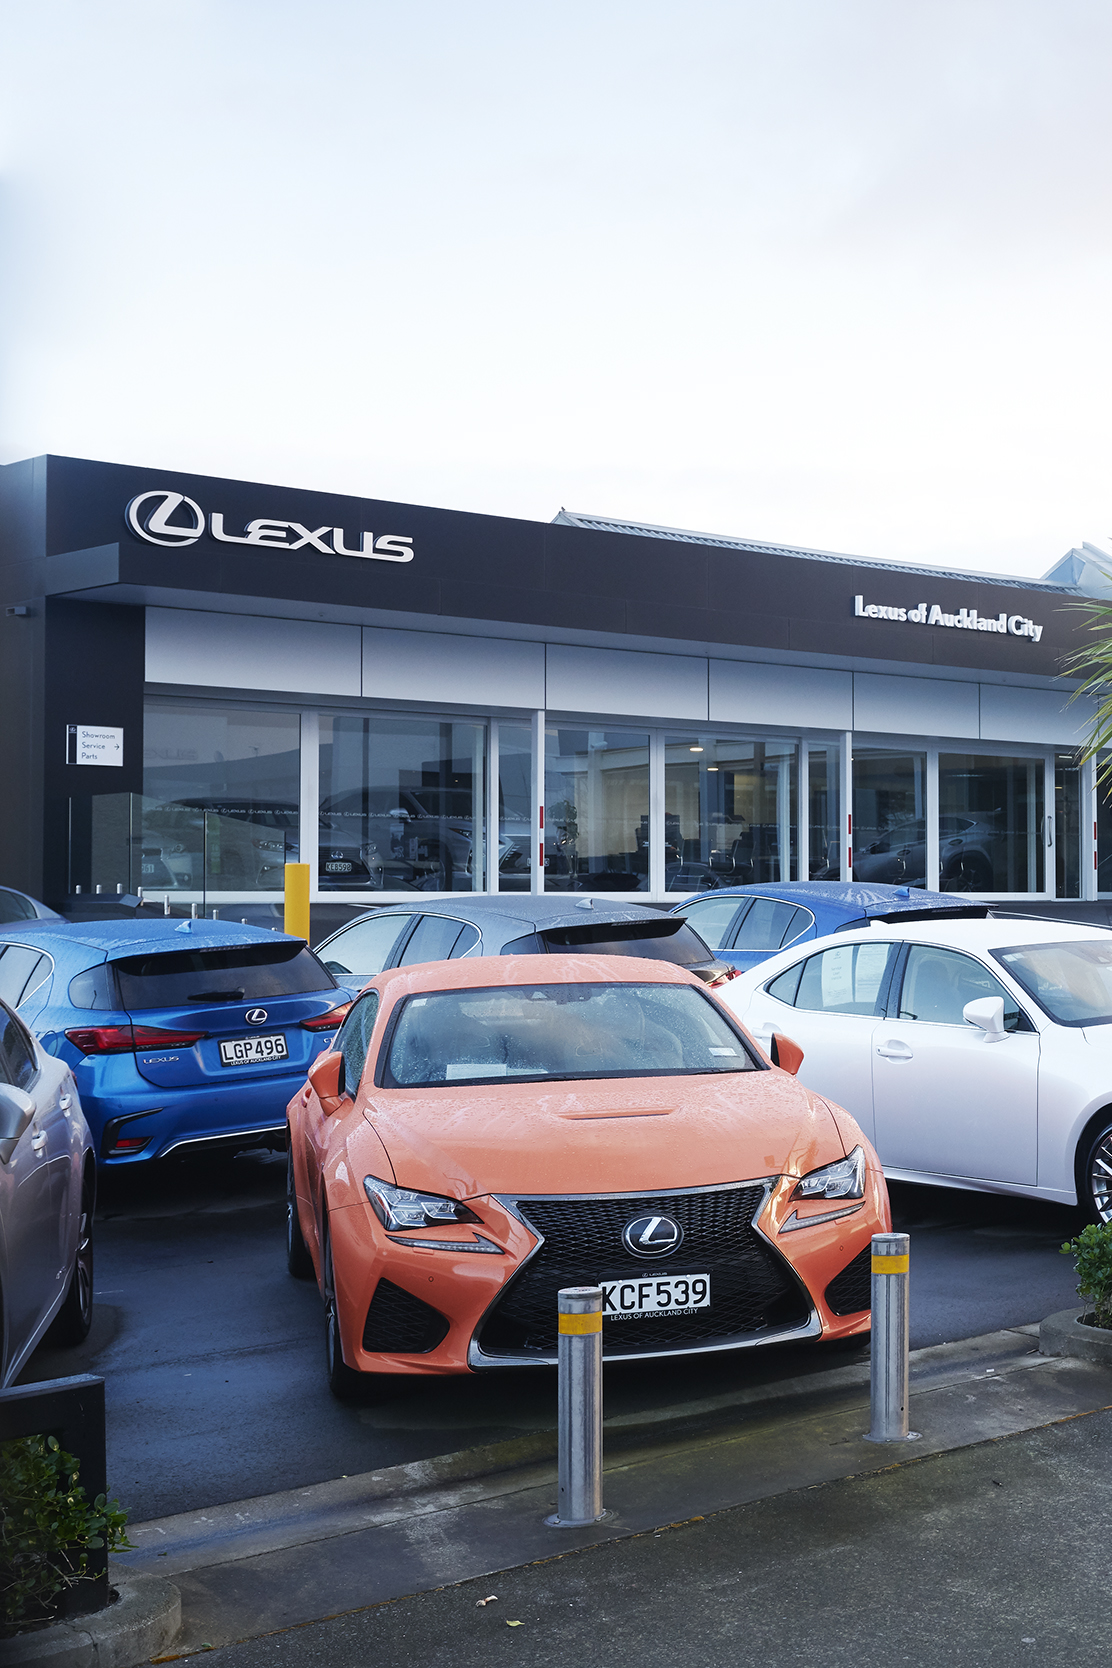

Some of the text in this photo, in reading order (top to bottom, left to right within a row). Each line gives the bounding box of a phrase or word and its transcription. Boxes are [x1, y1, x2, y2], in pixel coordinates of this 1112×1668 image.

[209, 512, 414, 563] LEXUS
[855, 594, 1044, 642] Lexus of Auckland City
[81, 730, 116, 739] Showroom
[81, 741, 106, 750] Service
[81, 751, 98, 760] Parts
[222, 1038, 285, 1062] LGP496
[143, 1055, 180, 1065] LEXUS
[602, 1278, 707, 1312] KCF539
[644, 1309, 682, 1319] AUCKLAND
[682, 1307, 698, 1315] CITY
